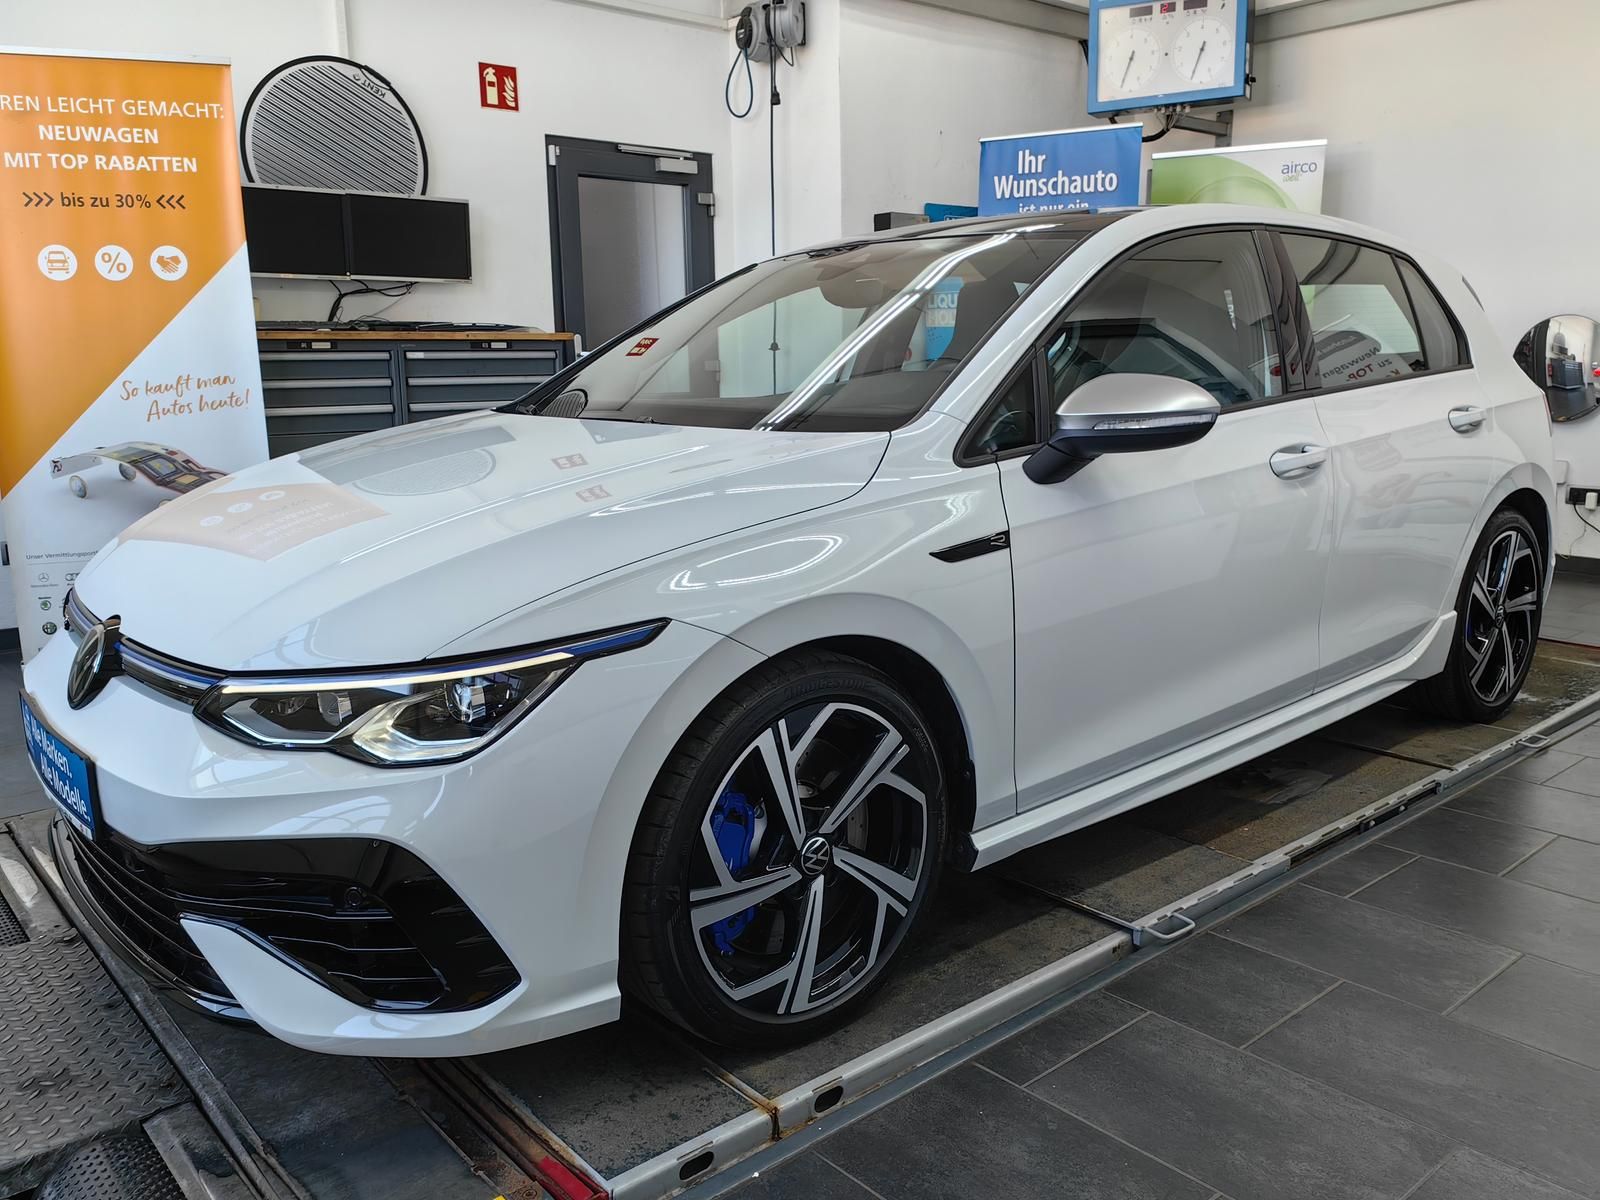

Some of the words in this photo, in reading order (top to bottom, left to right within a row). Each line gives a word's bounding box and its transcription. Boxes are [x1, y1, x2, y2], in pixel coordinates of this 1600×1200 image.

[361, 79, 386, 99] KENT
[47, 96, 115, 115] LEICHT
[121, 99, 225, 119] GEMACHT:
[38, 124, 159, 144] NEUWAGEN
[4, 152, 42, 168] MIT
[47, 153, 89, 170] TOP
[95, 156, 198, 172] RABATTEN
[1017, 149, 1046, 174] Ihr
[1281, 160, 1318, 175] airco
[993, 169, 1119, 200] Wunschauto
[61, 192, 85, 208] bis
[91, 195, 110, 208] zu
[116, 194, 152, 209] 30%
[119, 380, 139, 400] So
[145, 374, 191, 396] kauft
[196, 374, 236, 390] man
[146, 399, 193, 422] Autos
[198, 389, 251, 413] heute!
[41, 730, 73, 779] Marken.
[52, 767, 91, 822] Modelle.
